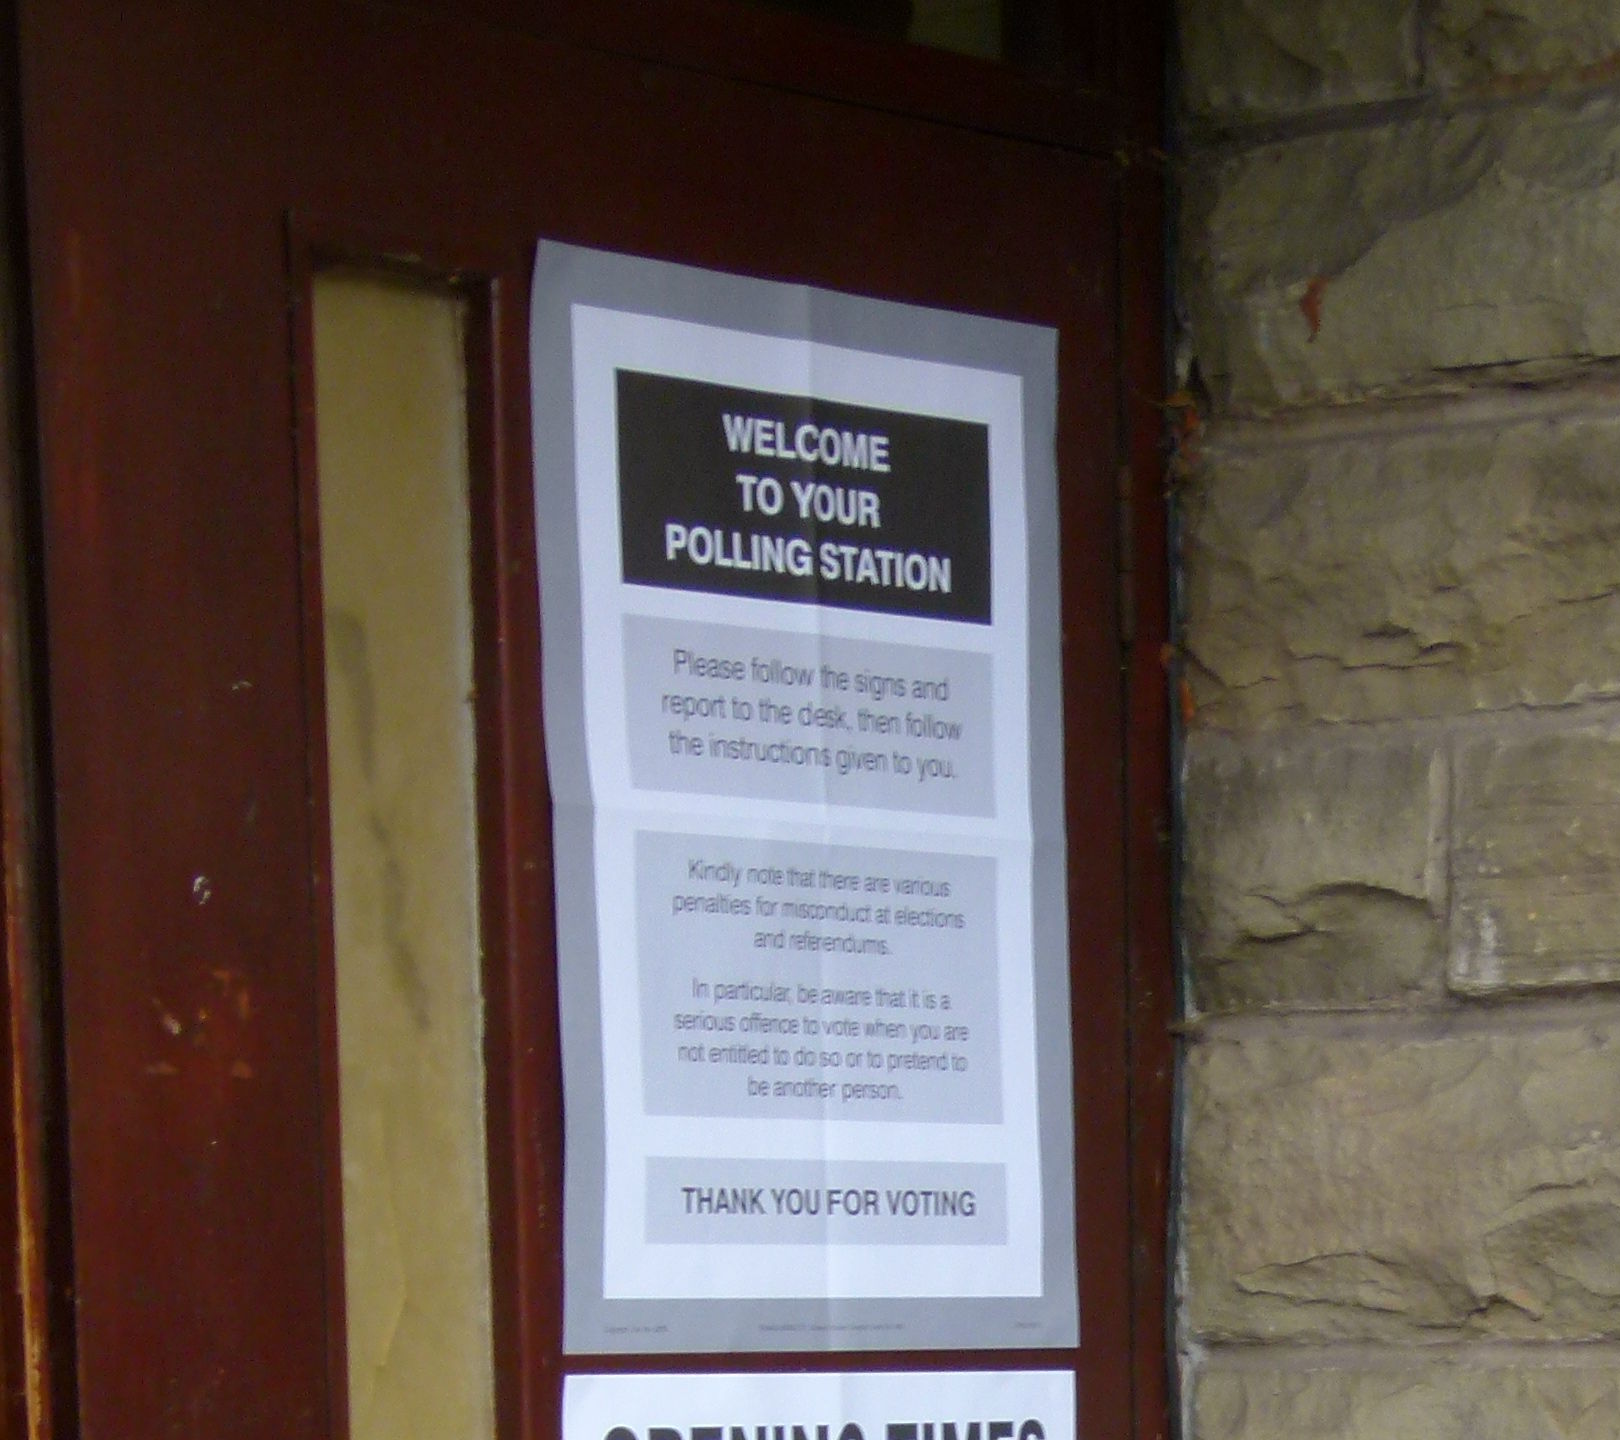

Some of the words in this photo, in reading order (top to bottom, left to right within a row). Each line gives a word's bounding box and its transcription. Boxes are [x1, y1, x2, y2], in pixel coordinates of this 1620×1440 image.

[722, 414, 891, 472] WELCOME
[736, 474, 784, 516] TO
[790, 481, 880, 528] YOUR
[665, 523, 814, 576] POLLING
[819, 542, 952, 594] STATION
[673, 649, 746, 681] Please
[751, 657, 814, 687] follow
[820, 665, 850, 691] the
[854, 669, 906, 701] signs
[911, 677, 949, 701] and
[661, 693, 726, 721] report
[732, 697, 751, 720] to
[759, 698, 792, 724] the
[857, 708, 900, 734] then
[905, 712, 963, 740] follow
[669, 730, 704, 756] the
[709, 733, 832, 767] instructions
[836, 749, 887, 774] given
[893, 751, 912, 774] to
[917, 755, 956, 782] you.
[688, 859, 742, 888] Kindly
[746, 866, 784, 886] note
[787, 867, 816, 887] that
[818, 870, 860, 892] there
[864, 876, 890, 893] are
[893, 878, 952, 898] various
[672, 894, 750, 916] penalties
[756, 896, 778, 916] for
[782, 901, 872, 924] misconduct
[875, 907, 890, 926] at
[894, 908, 966, 928] elections
[754, 930, 784, 949] and
[692, 978, 710, 999] In
[797, 984, 818, 1004] be
[821, 988, 872, 1006] aware
[875, 988, 906, 1008] that
[908, 989, 919, 1008] it
[922, 990, 938, 1010] is
[940, 994, 952, 1010] a
[673, 1010, 736, 1032] serious
[739, 1012, 799, 1034] offence
[802, 1016, 820, 1035] to
[822, 1018, 860, 1037] vote
[864, 1019, 908, 1039] when
[910, 1024, 940, 1044] you
[943, 1024, 970, 1042] are
[678, 1044, 706, 1062] not
[708, 1044, 770, 1066] entitled
[773, 1048, 790, 1066] to
[794, 1048, 818, 1066] do
[819, 1050, 840, 1067] so
[844, 1051, 863, 1068] or
[866, 1050, 882, 1069] to
[886, 1051, 948, 1072] pretend
[950, 1054, 968, 1072] to
[748, 1076, 770, 1096] be
[772, 1078, 836, 1098] another
[842, 1082, 902, 1102] person.
[681, 1186, 765, 1217] THANK
[769, 1187, 819, 1217] YOU
[826, 1189, 880, 1218] FOR
[885, 1189, 977, 1219] VOTING
